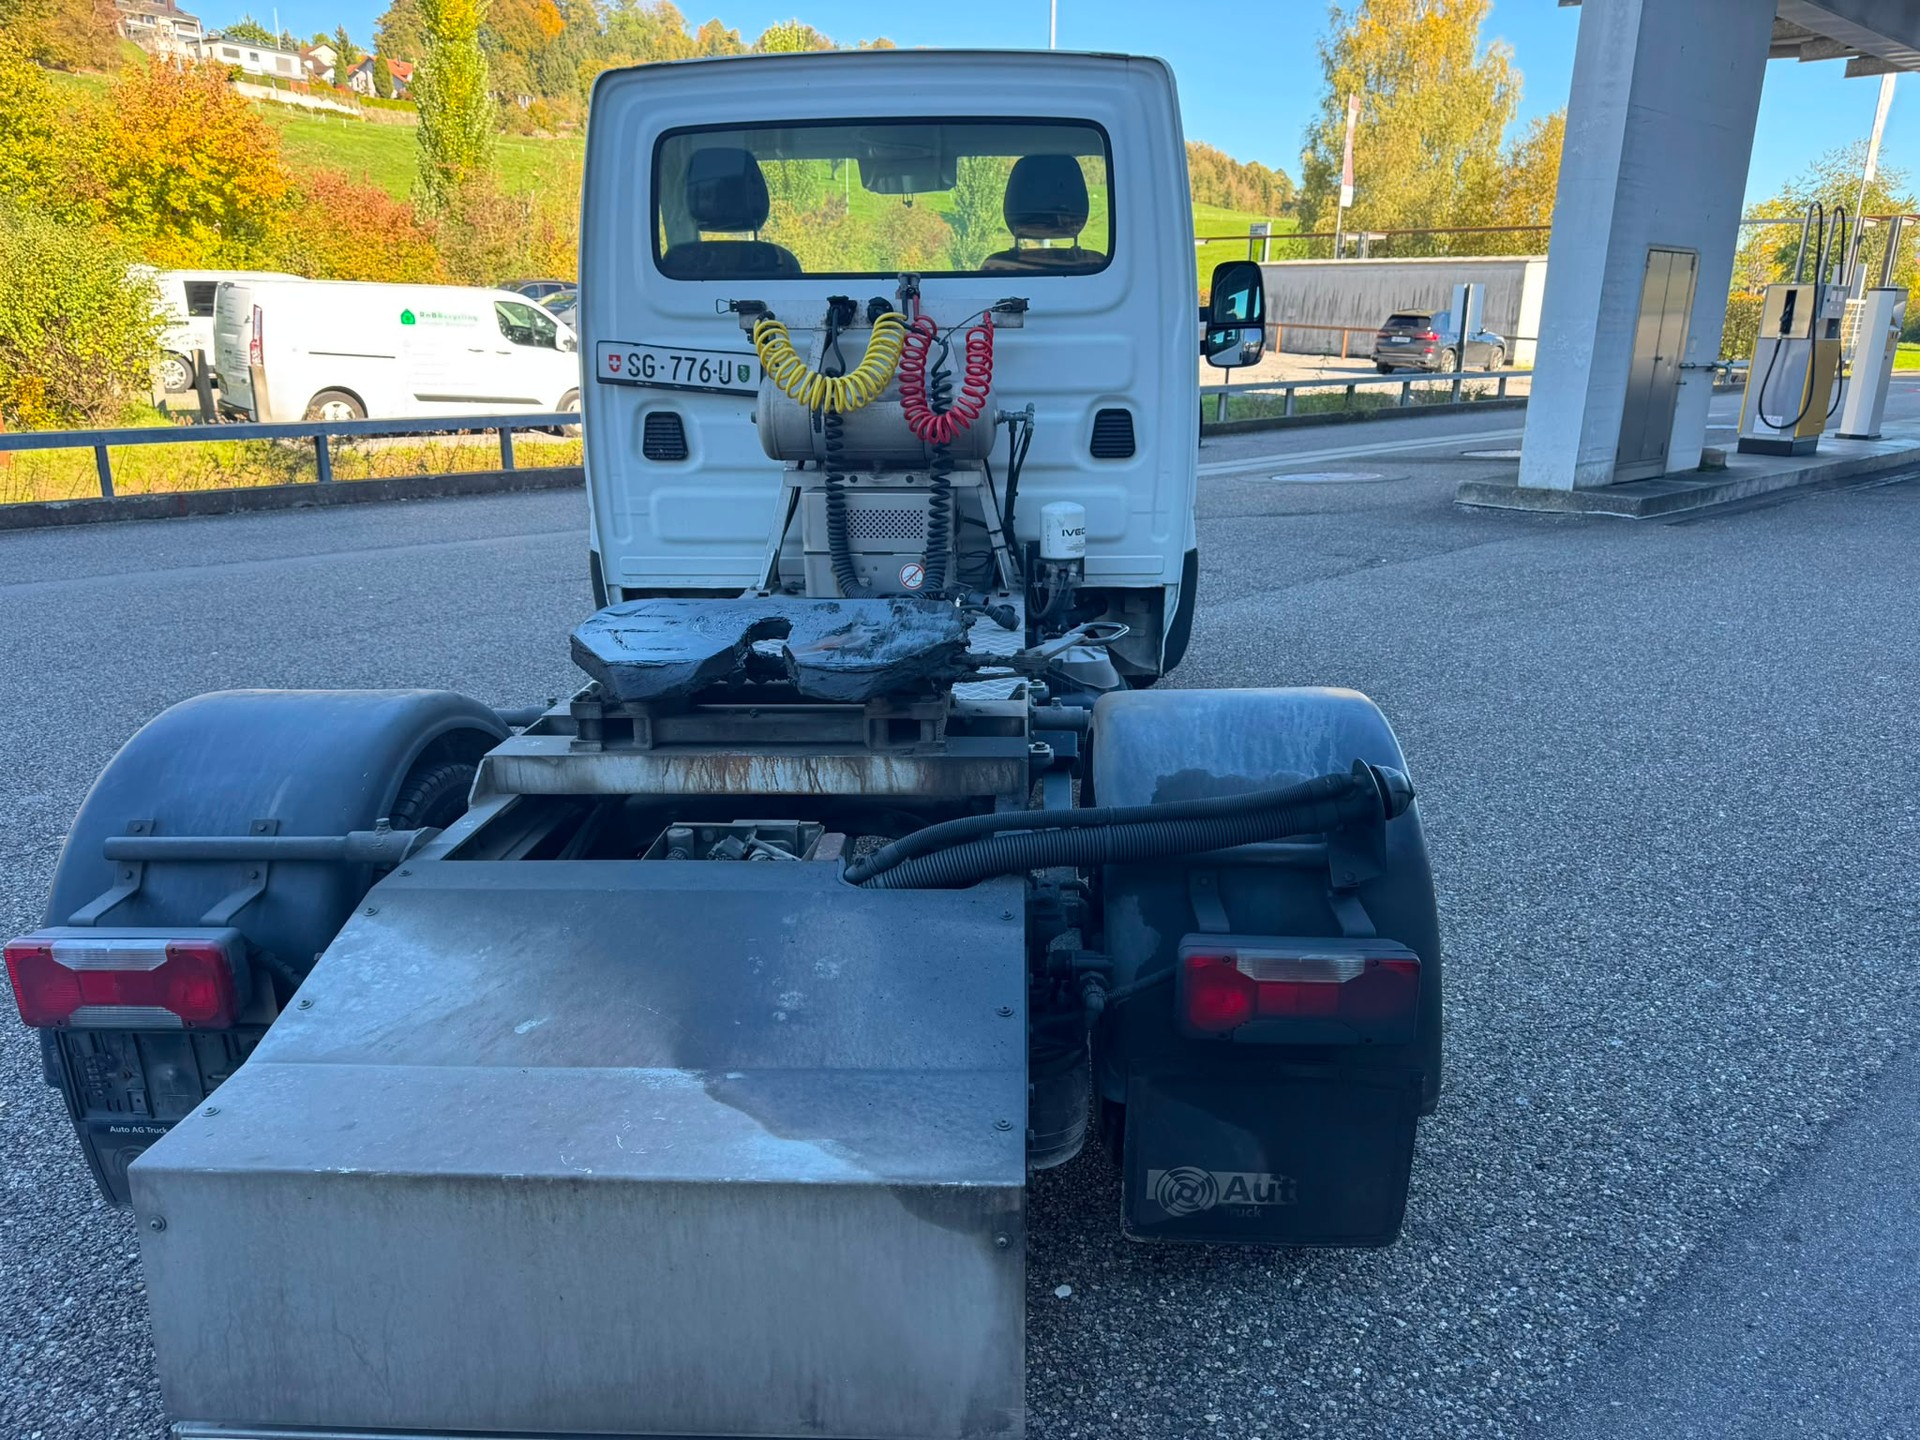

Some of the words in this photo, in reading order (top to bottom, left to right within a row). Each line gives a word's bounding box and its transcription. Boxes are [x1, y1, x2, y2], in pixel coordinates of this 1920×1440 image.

[109, 1125, 130, 1134] Auto
[132, 1125, 144, 1134] AG
[145, 1126, 167, 1135] Truck
